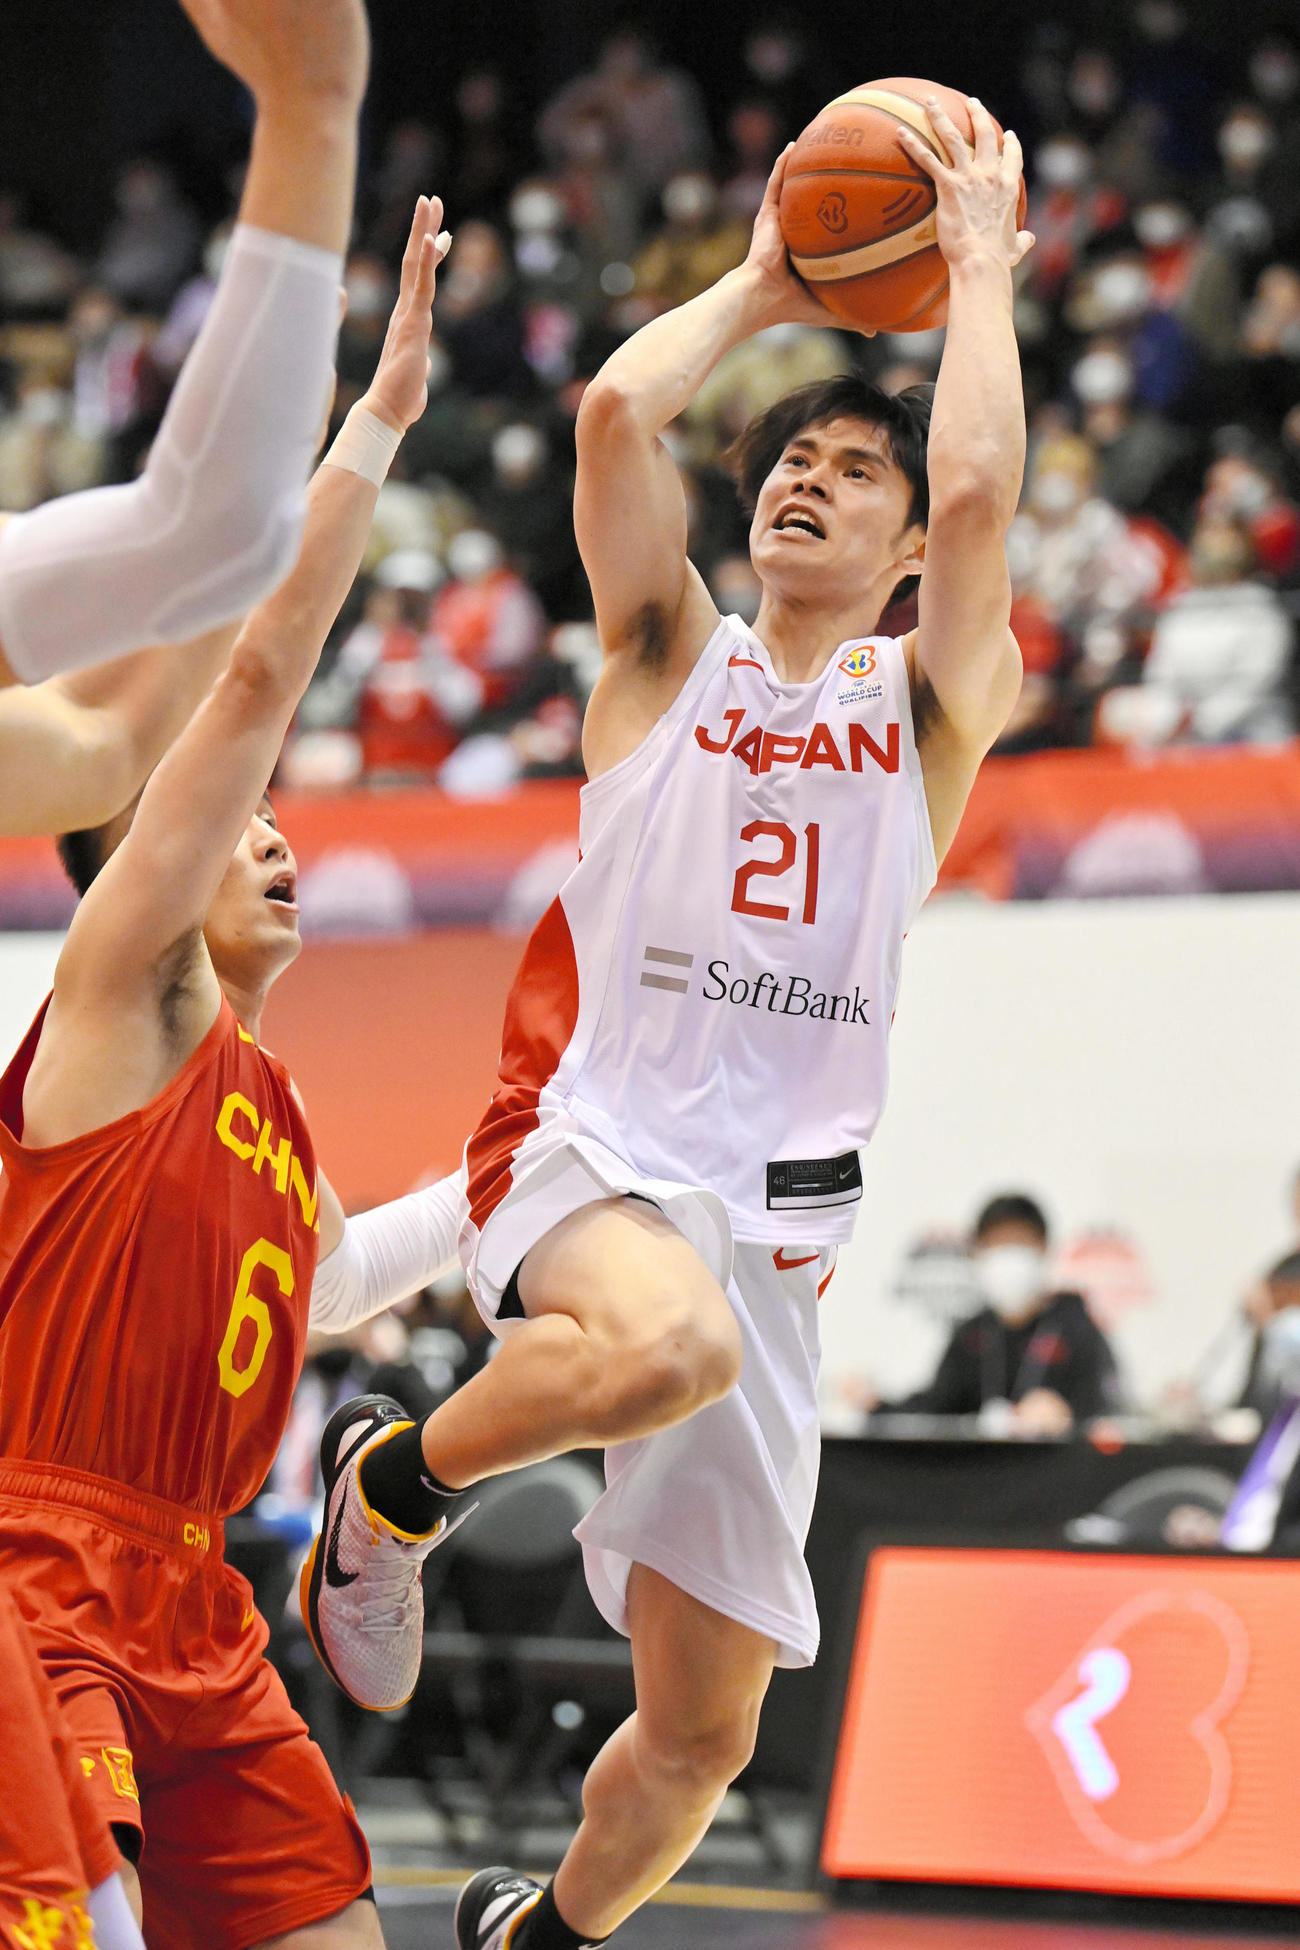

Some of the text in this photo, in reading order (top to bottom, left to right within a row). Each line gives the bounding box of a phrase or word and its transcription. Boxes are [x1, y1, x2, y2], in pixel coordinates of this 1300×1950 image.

[837, 685, 882, 701] WORLD CUP
[838, 692, 883, 706] QUALIFIERS
[694, 709, 900, 776] JAPAN
[731, 819, 820, 925] 21
[702, 960, 870, 1025] SoftBank
[217, 1237, 294, 1398] 6
